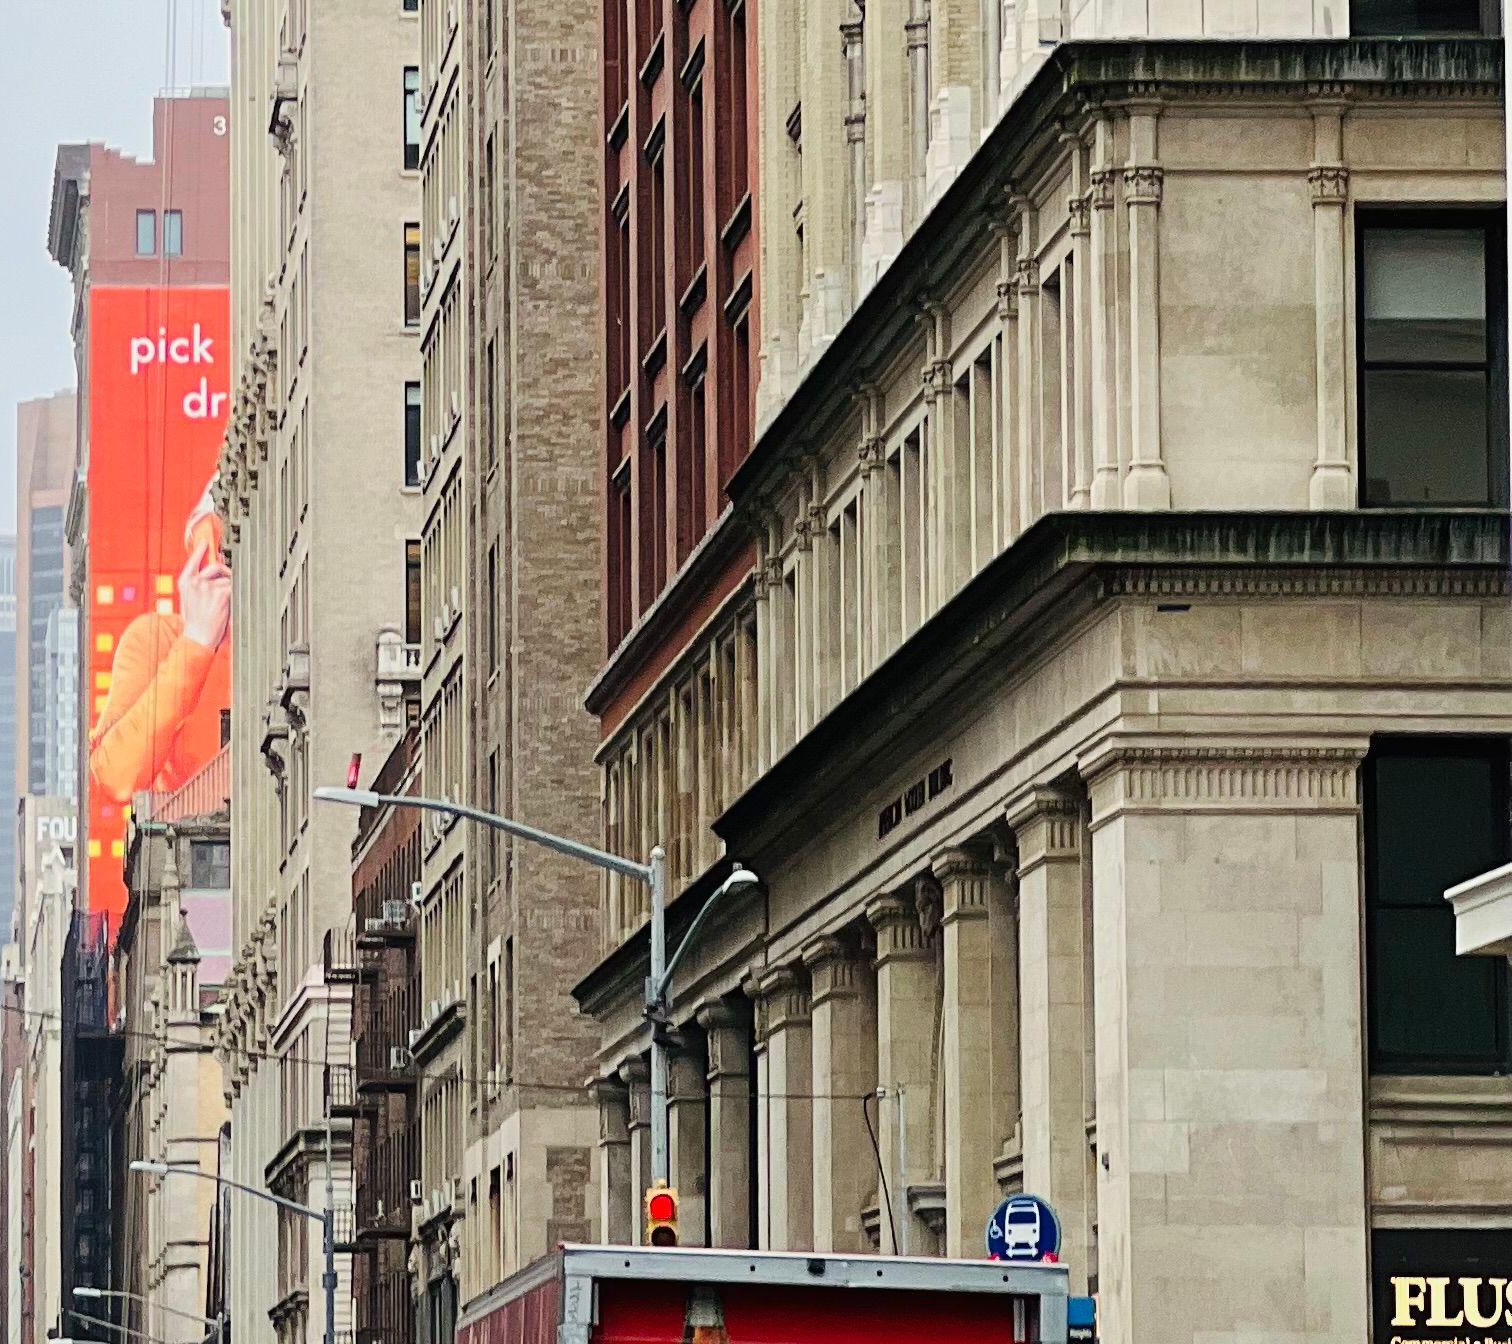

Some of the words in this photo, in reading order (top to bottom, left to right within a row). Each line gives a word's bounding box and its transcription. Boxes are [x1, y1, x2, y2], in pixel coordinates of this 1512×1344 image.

[213, 115, 227, 136] 3
[130, 322, 215, 375] pick
[183, 375, 228, 419] dr
[1390, 1276, 1512, 1328] FLU
